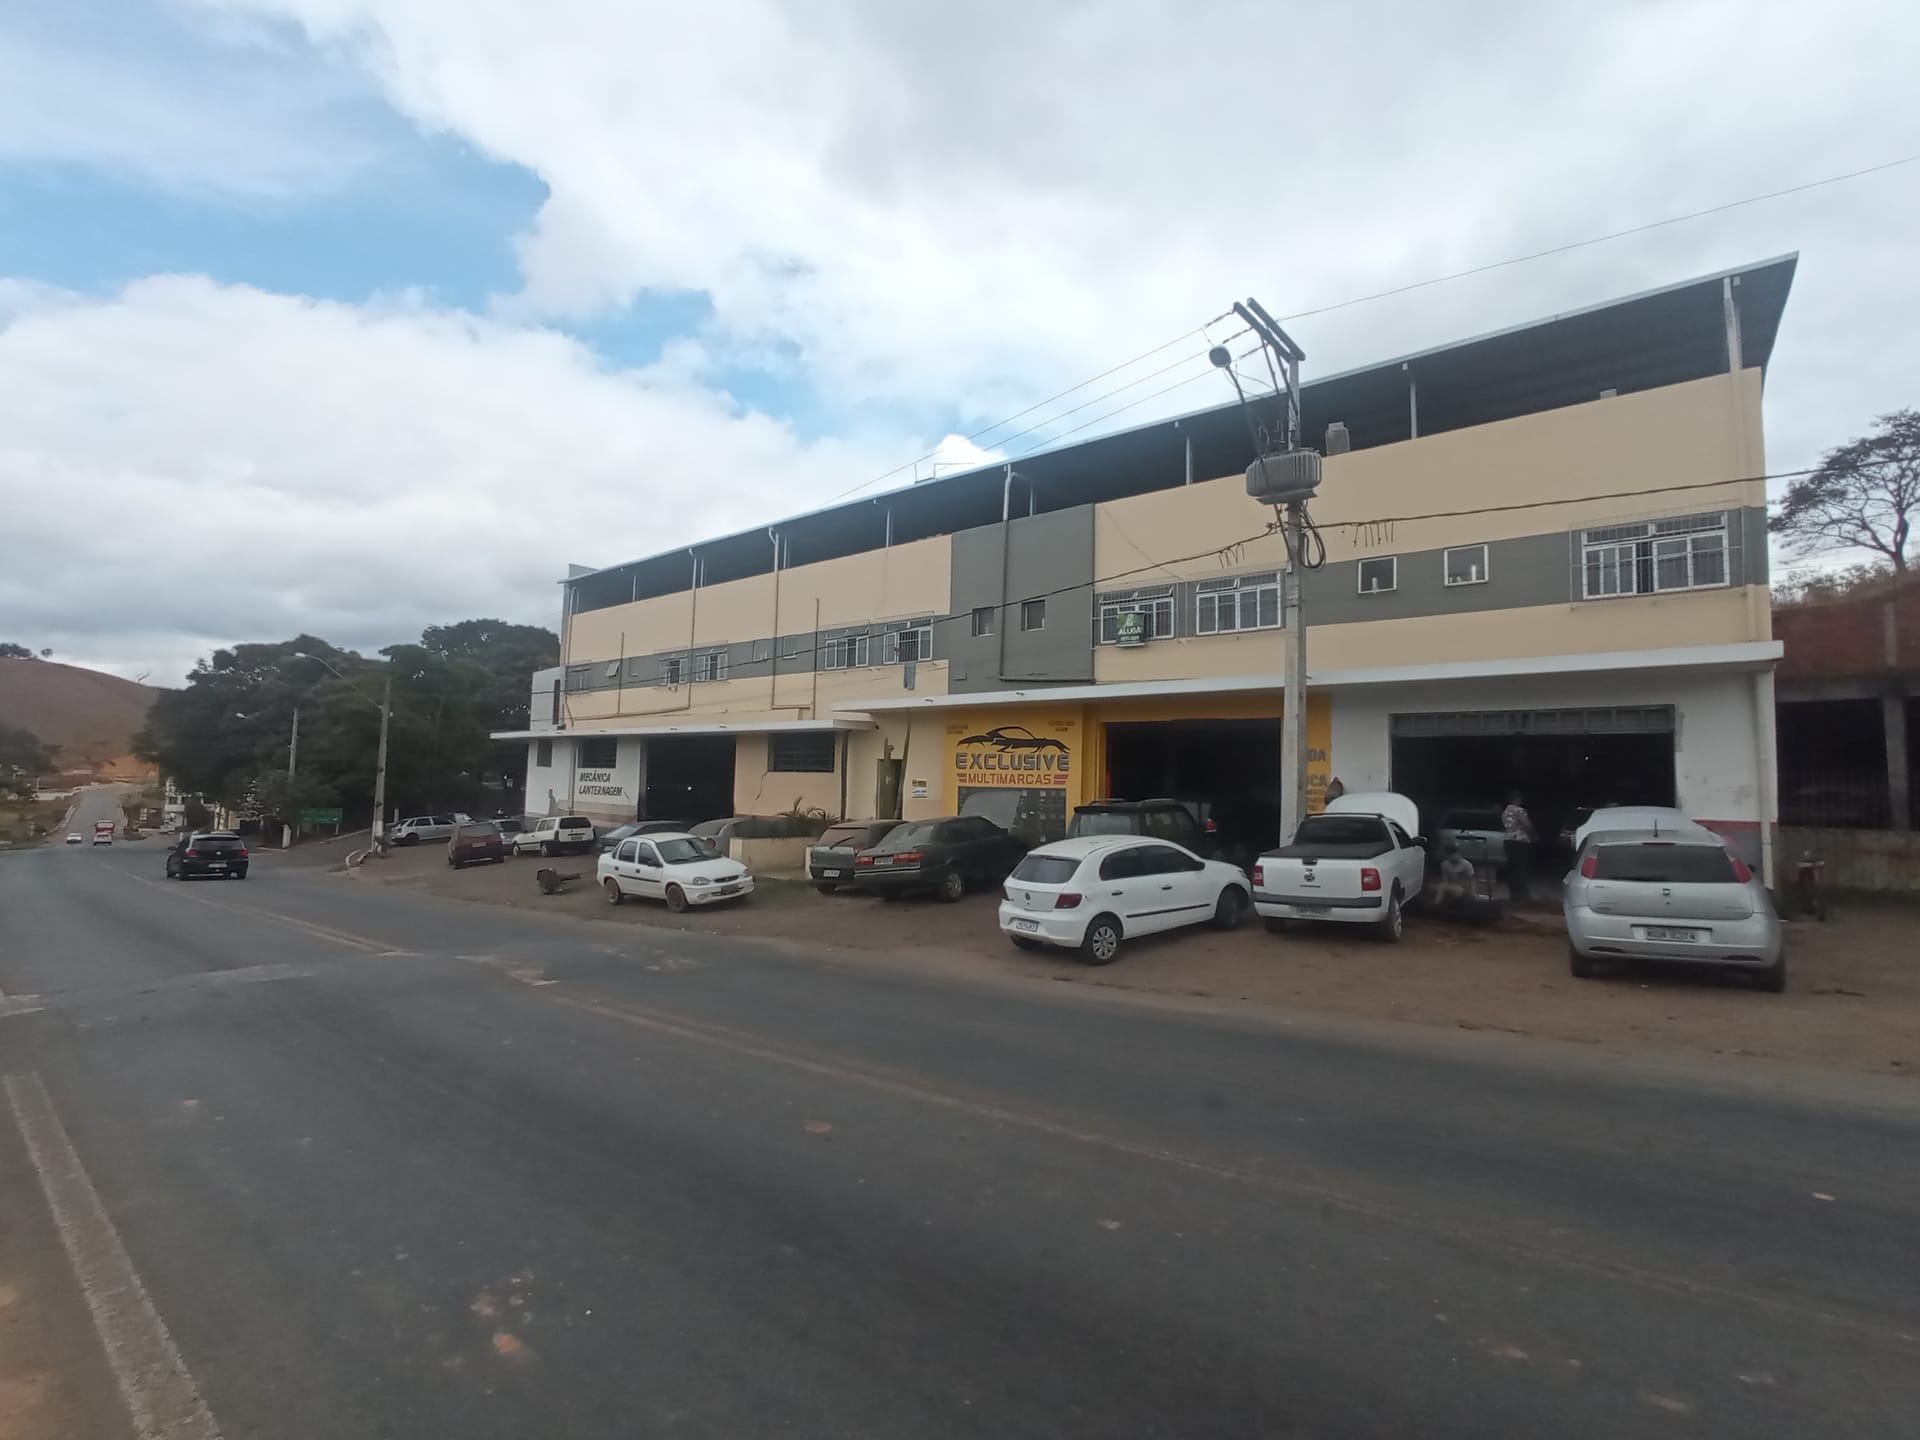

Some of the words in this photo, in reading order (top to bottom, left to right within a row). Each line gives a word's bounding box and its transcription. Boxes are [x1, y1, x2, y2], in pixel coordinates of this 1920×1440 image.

[955, 752, 1070, 771] EXCLUSIVE
[579, 770, 611, 783] MECÂNICA
[968, 772, 1052, 785] MULTIMARCAS
[578, 785, 622, 796] LANTERNAGEM
